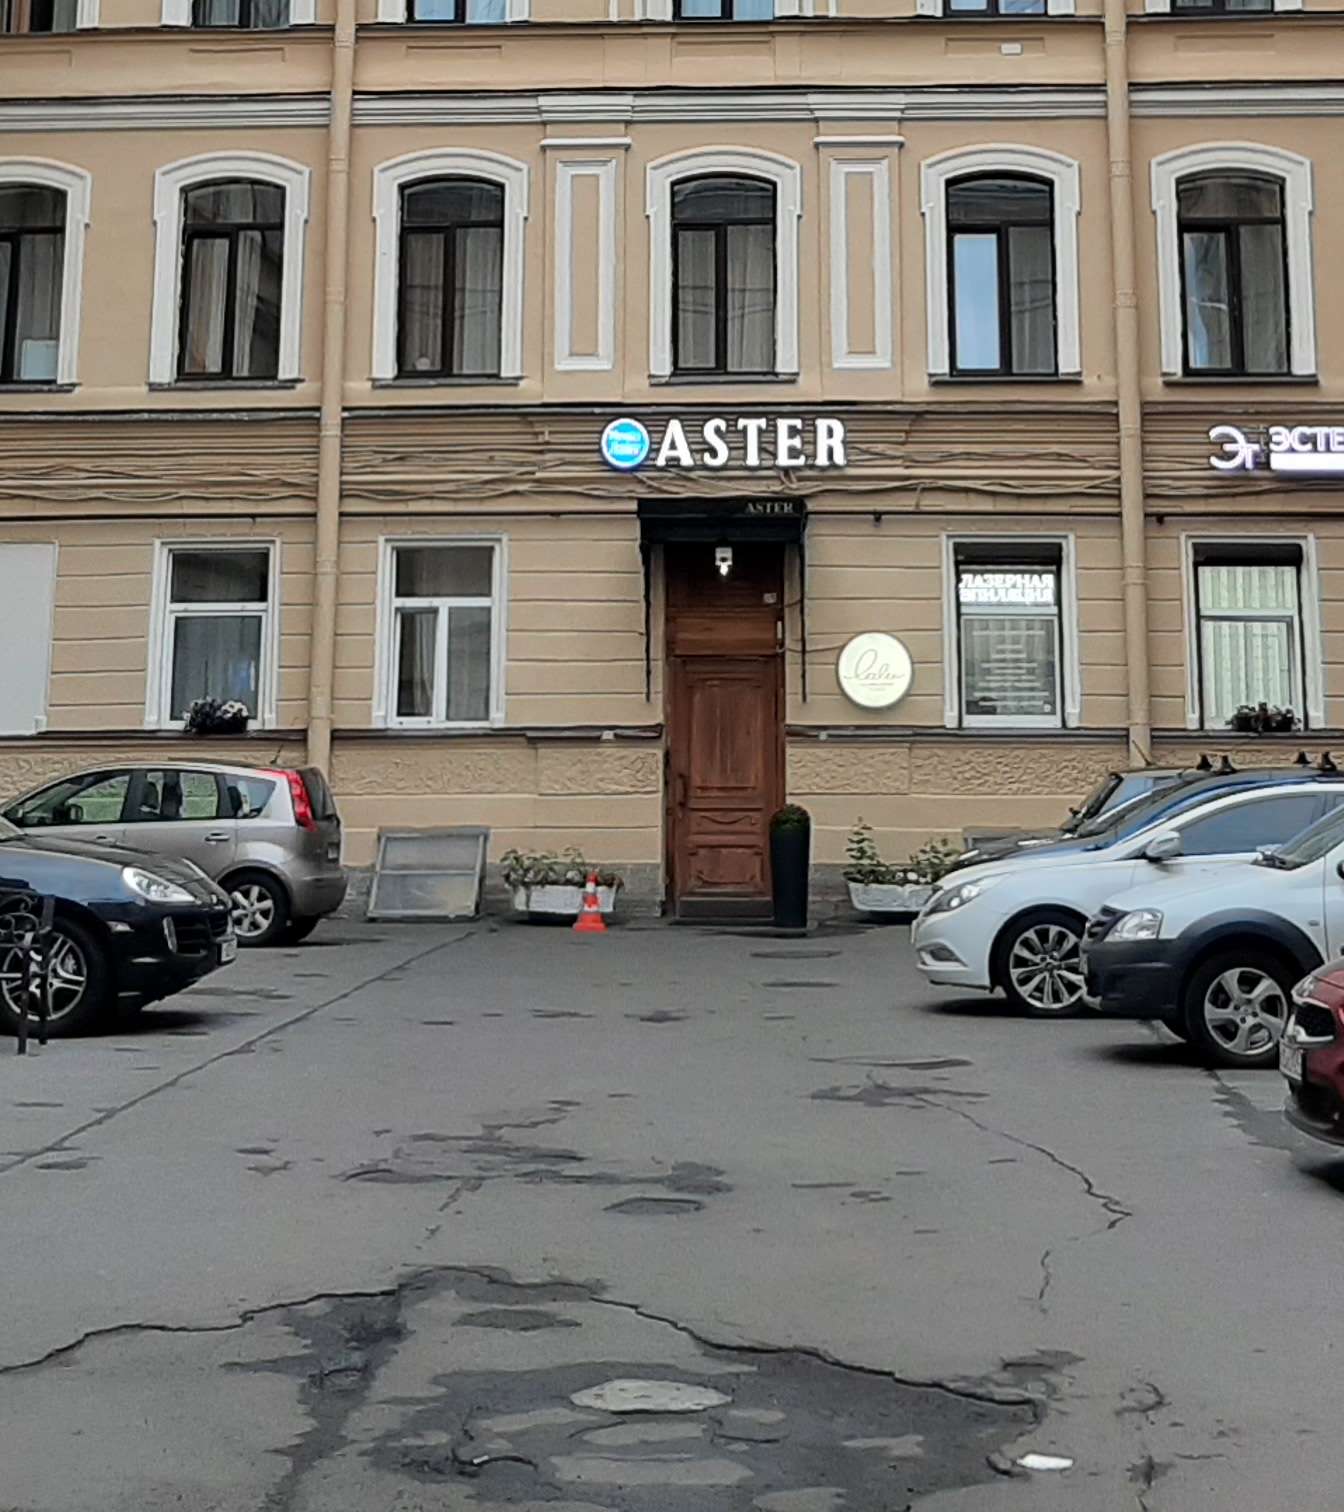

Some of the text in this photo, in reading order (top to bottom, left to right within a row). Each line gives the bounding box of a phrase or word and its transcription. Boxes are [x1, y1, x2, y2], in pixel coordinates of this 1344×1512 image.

[656, 418, 847, 467] ASTER
[745, 501, 794, 514] ASTER
[958, 573, 1055, 589] ЛАЗЕРНАЯ
